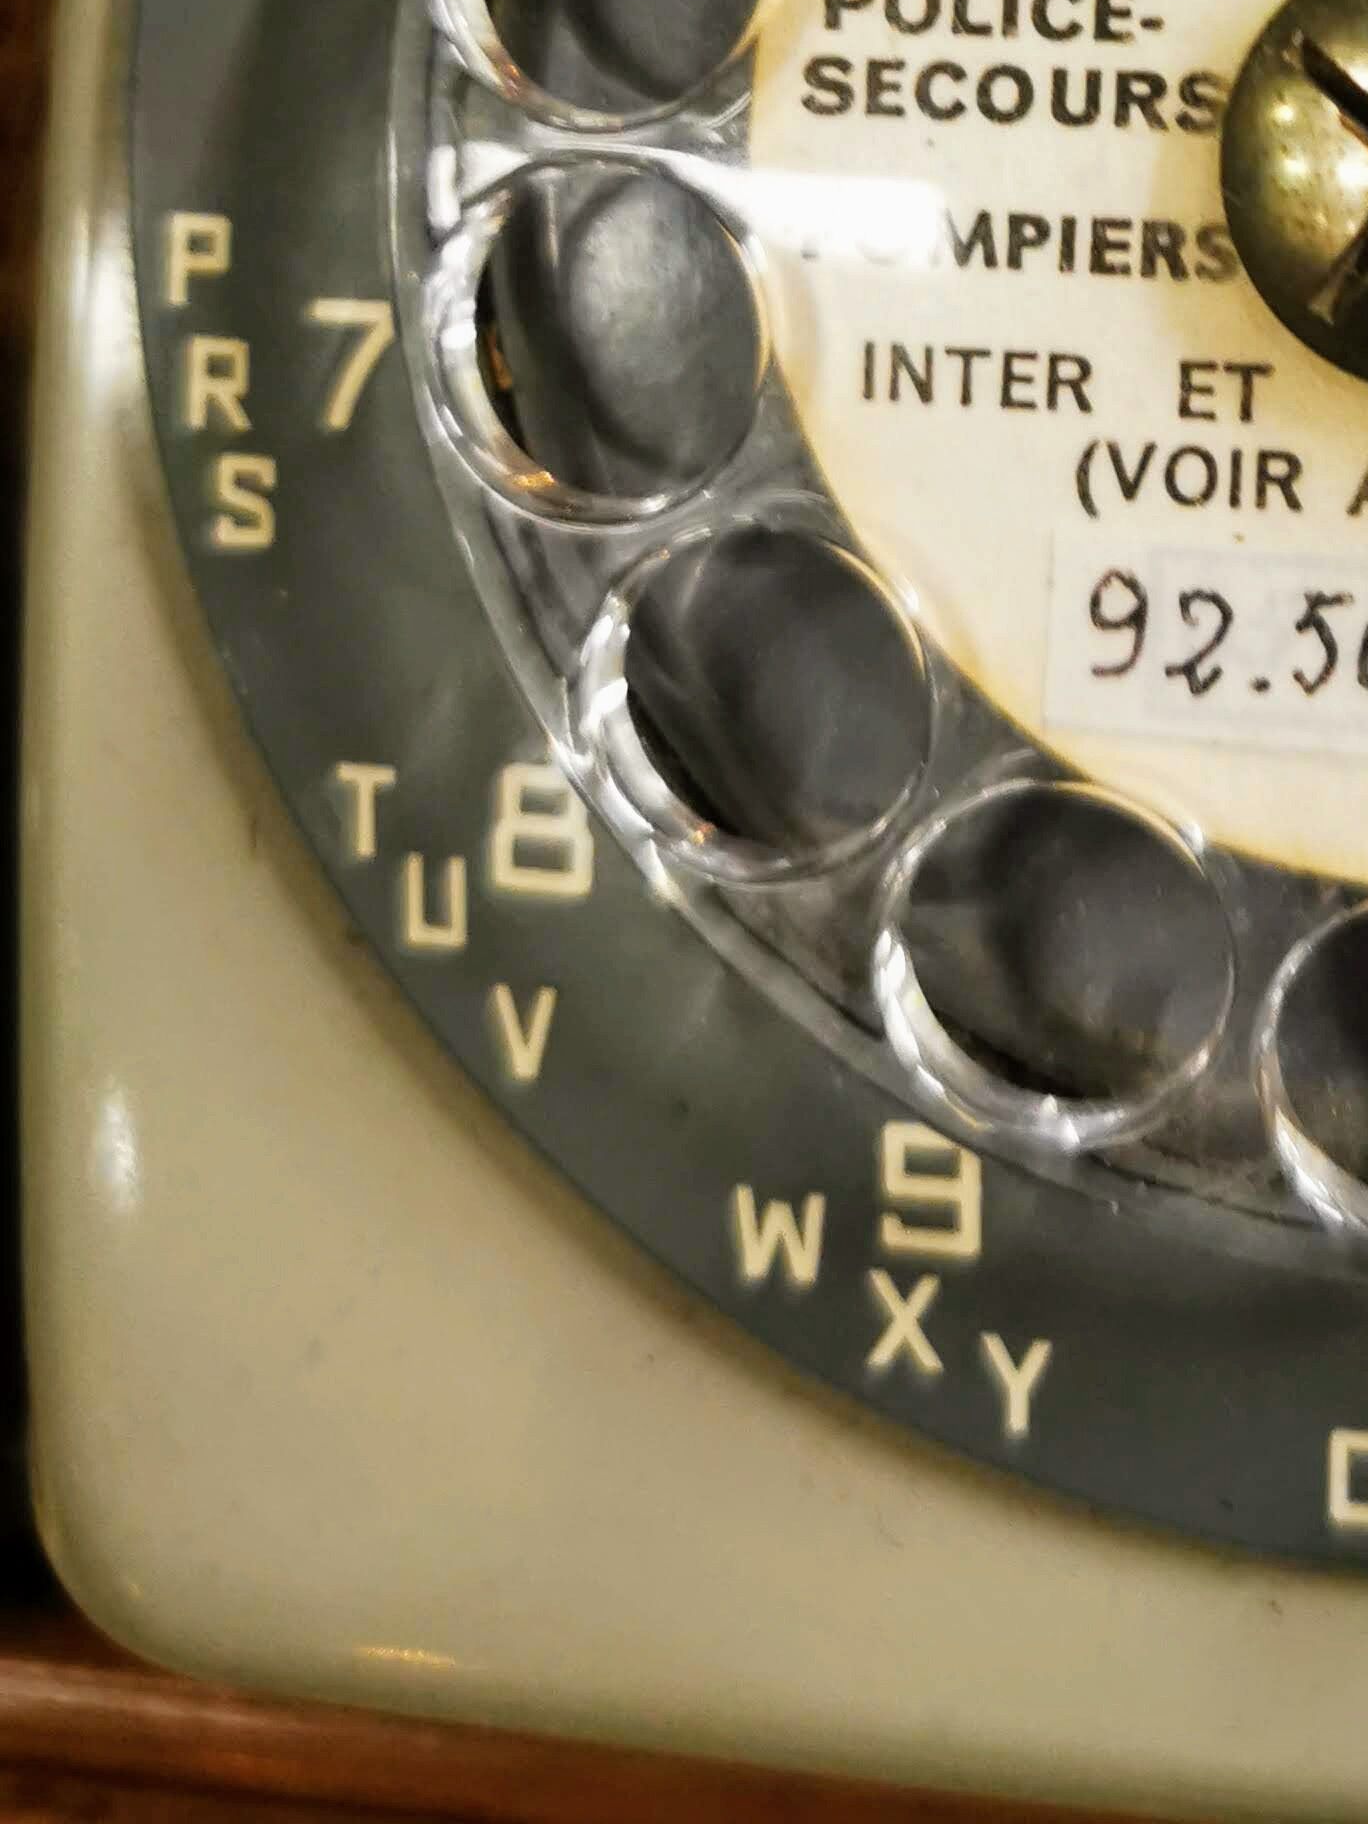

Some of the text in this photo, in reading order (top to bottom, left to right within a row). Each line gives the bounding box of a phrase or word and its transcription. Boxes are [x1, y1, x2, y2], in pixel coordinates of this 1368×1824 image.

[801, 54, 1231, 134] SECOURS
[800, 210, 1240, 283] MPIERS
[304, 295, 396, 432] 7
[862, 339, 1095, 414] INTER
[1177, 359, 1273, 424] ET
[1075, 438, 1302, 518] (VOIR
[492, 761, 595, 898] 8
[881, 1118, 984, 1259] 9
